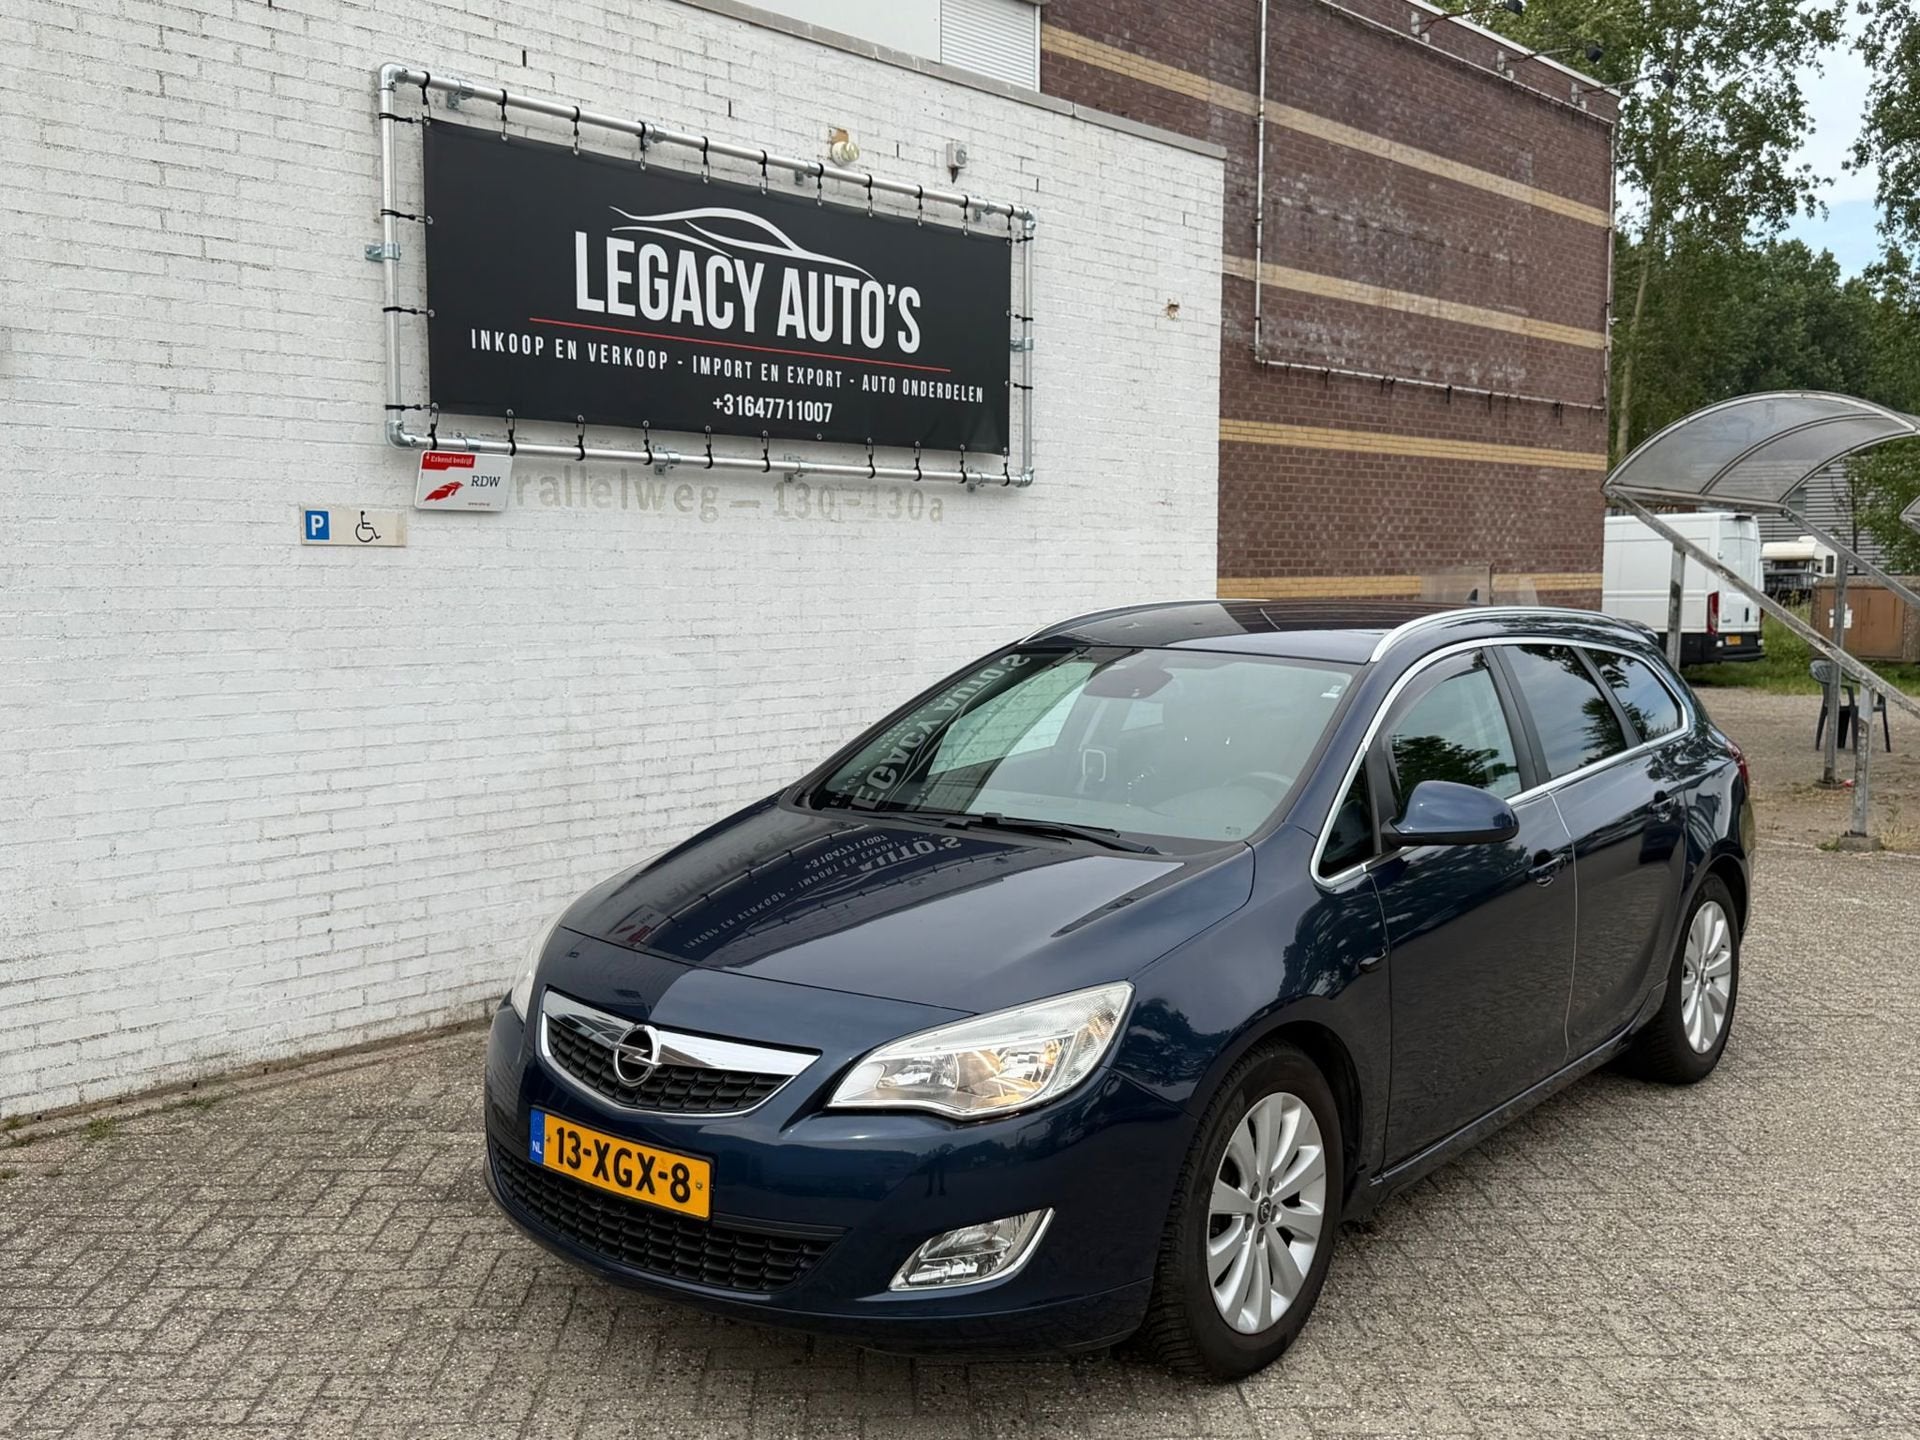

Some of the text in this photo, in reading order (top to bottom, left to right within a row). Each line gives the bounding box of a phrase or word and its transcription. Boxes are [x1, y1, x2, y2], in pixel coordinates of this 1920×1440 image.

[575, 231, 921, 354] LEGACY AUTO'S
[471, 328, 544, 355] INKOOP
[555, 338, 577, 360] EN
[587, 342, 668, 370] VERKOOP
[693, 354, 752, 379] IMPORT
[761, 363, 779, 382] EN
[787, 366, 842, 388] EXPORT
[862, 374, 896, 394] AUTO
[902, 379, 983, 403] ONDERDELEN
[712, 393, 833, 423] +31647711007
[471, 475, 501, 488] RDW
[515, 464, 720, 523] rallelweg
[310, 514, 325, 537] P
[532, 1141, 542, 1154] NL
[556, 1126, 691, 1204] 13-XGX-8
